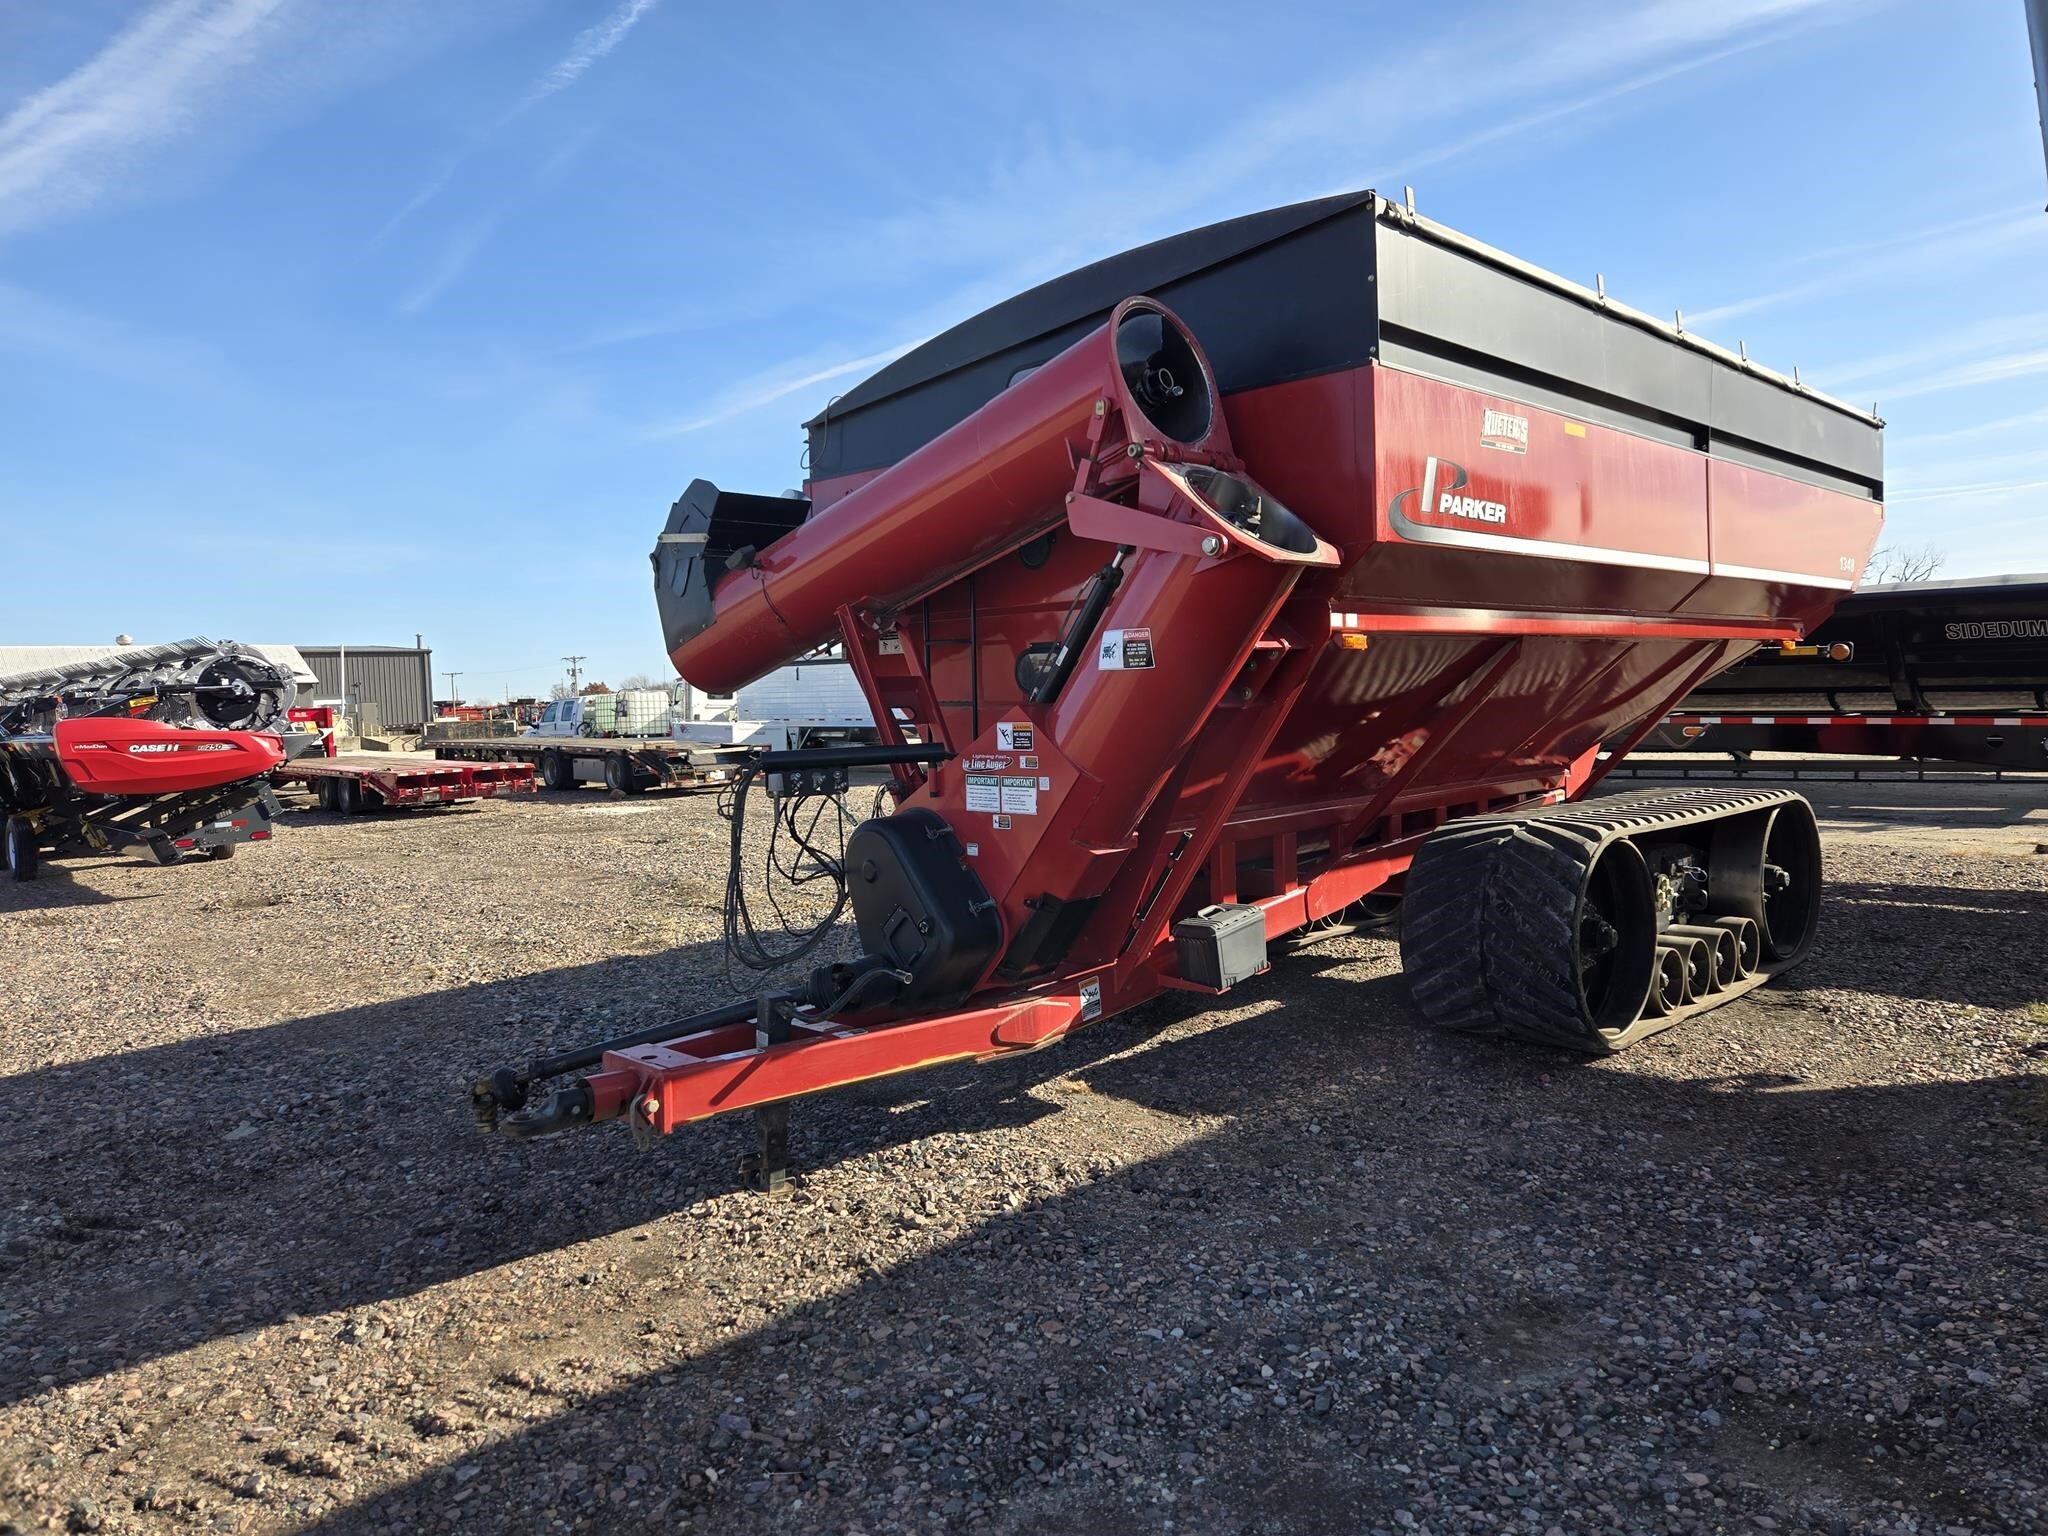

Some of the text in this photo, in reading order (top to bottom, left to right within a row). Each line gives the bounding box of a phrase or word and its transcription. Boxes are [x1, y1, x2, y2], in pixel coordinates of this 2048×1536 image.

[1439, 493, 1507, 524] PARKER
[128, 744, 163, 753] CASE
[985, 759, 1006, 770] Auger
[967, 776, 998, 785] IMPORTANT
[1003, 778, 1033, 787] IMPORTANT
